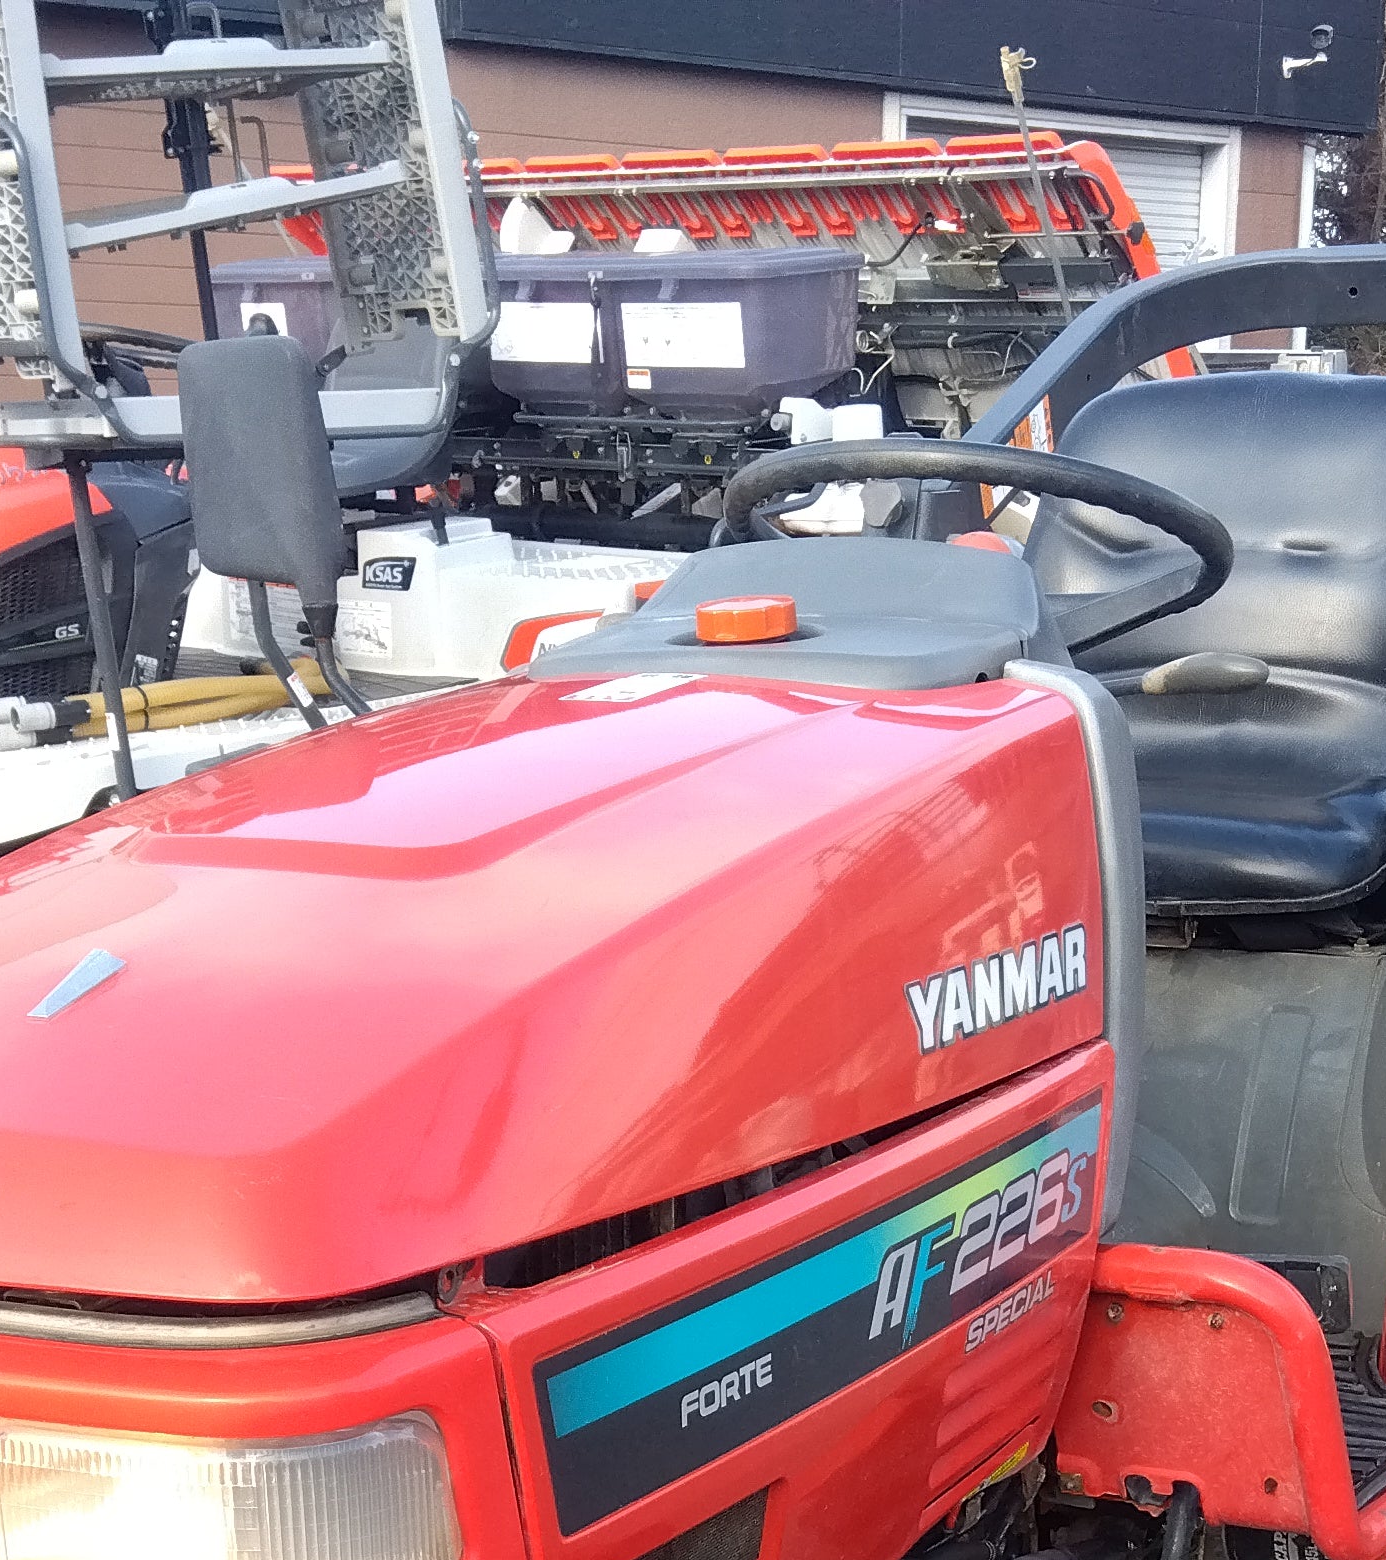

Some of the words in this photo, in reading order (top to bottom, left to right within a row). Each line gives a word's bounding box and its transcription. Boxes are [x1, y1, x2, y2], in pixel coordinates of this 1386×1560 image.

[365, 564, 404, 583] KSAS
[55, 624, 80, 639] GS
[904, 923, 1088, 1055] YANMAR
[965, 1269, 1056, 1354] SPECIAL
[680, 1352, 774, 1428] FORTE
